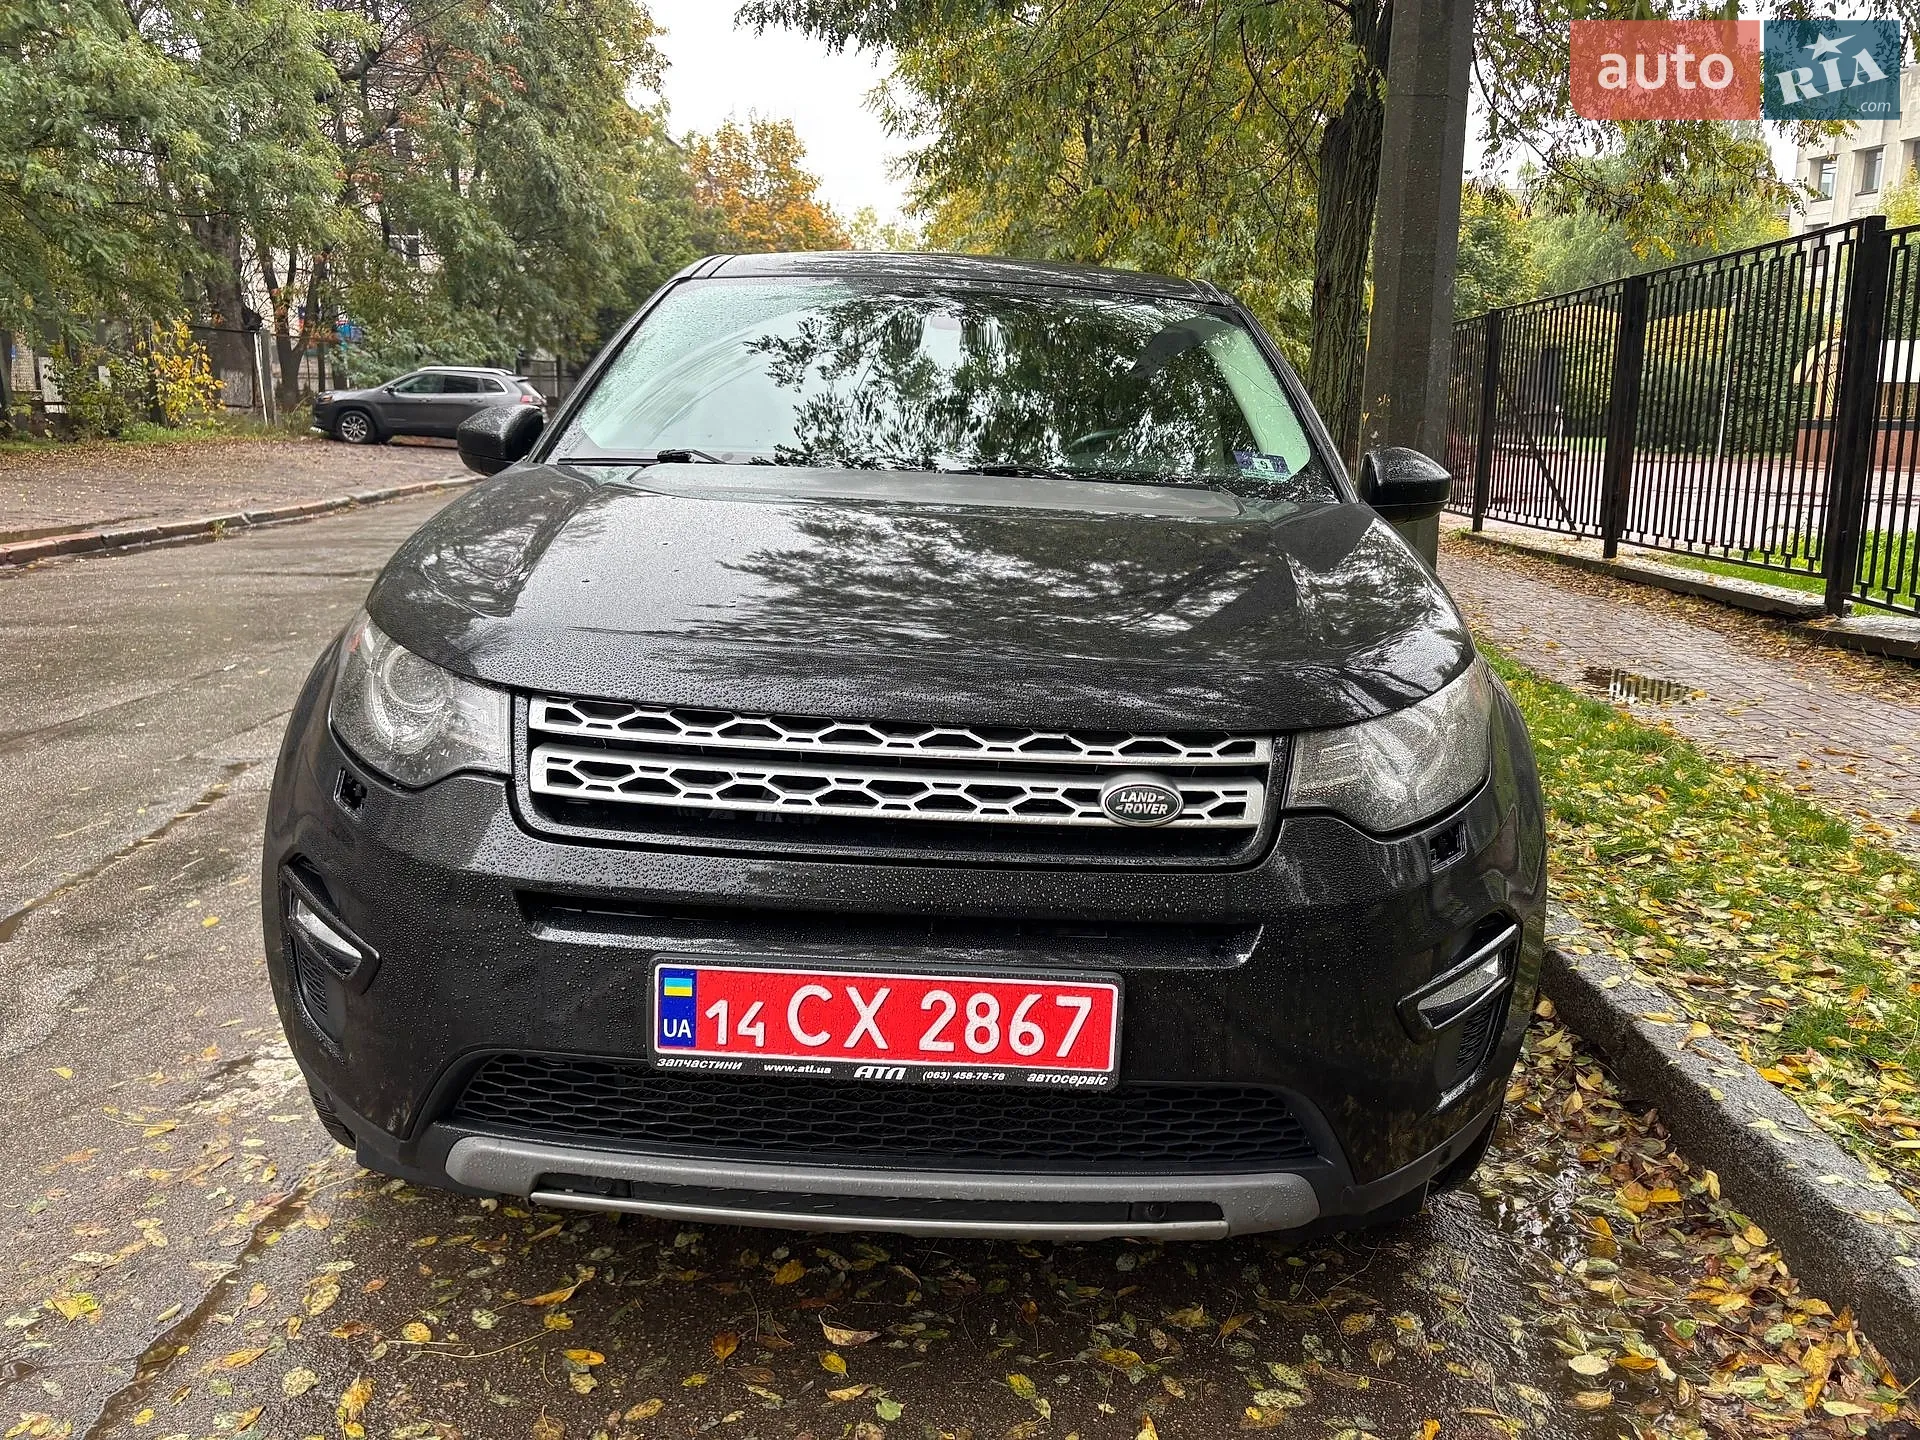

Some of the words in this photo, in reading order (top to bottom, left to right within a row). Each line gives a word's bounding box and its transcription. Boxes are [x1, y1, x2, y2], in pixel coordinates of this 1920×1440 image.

[1120, 792, 1157, 803] LAND
[1123, 803, 1168, 815] ROVER
[705, 999, 765, 1048] 14
[786, 984, 891, 1050] CX
[918, 989, 1092, 1058] 2867
[663, 1018, 692, 1038] UA
[656, 1058, 743, 1070] запчастини
[922, 1071, 951, 1081] (063)
[1027, 1073, 1108, 1087] автосервіс
